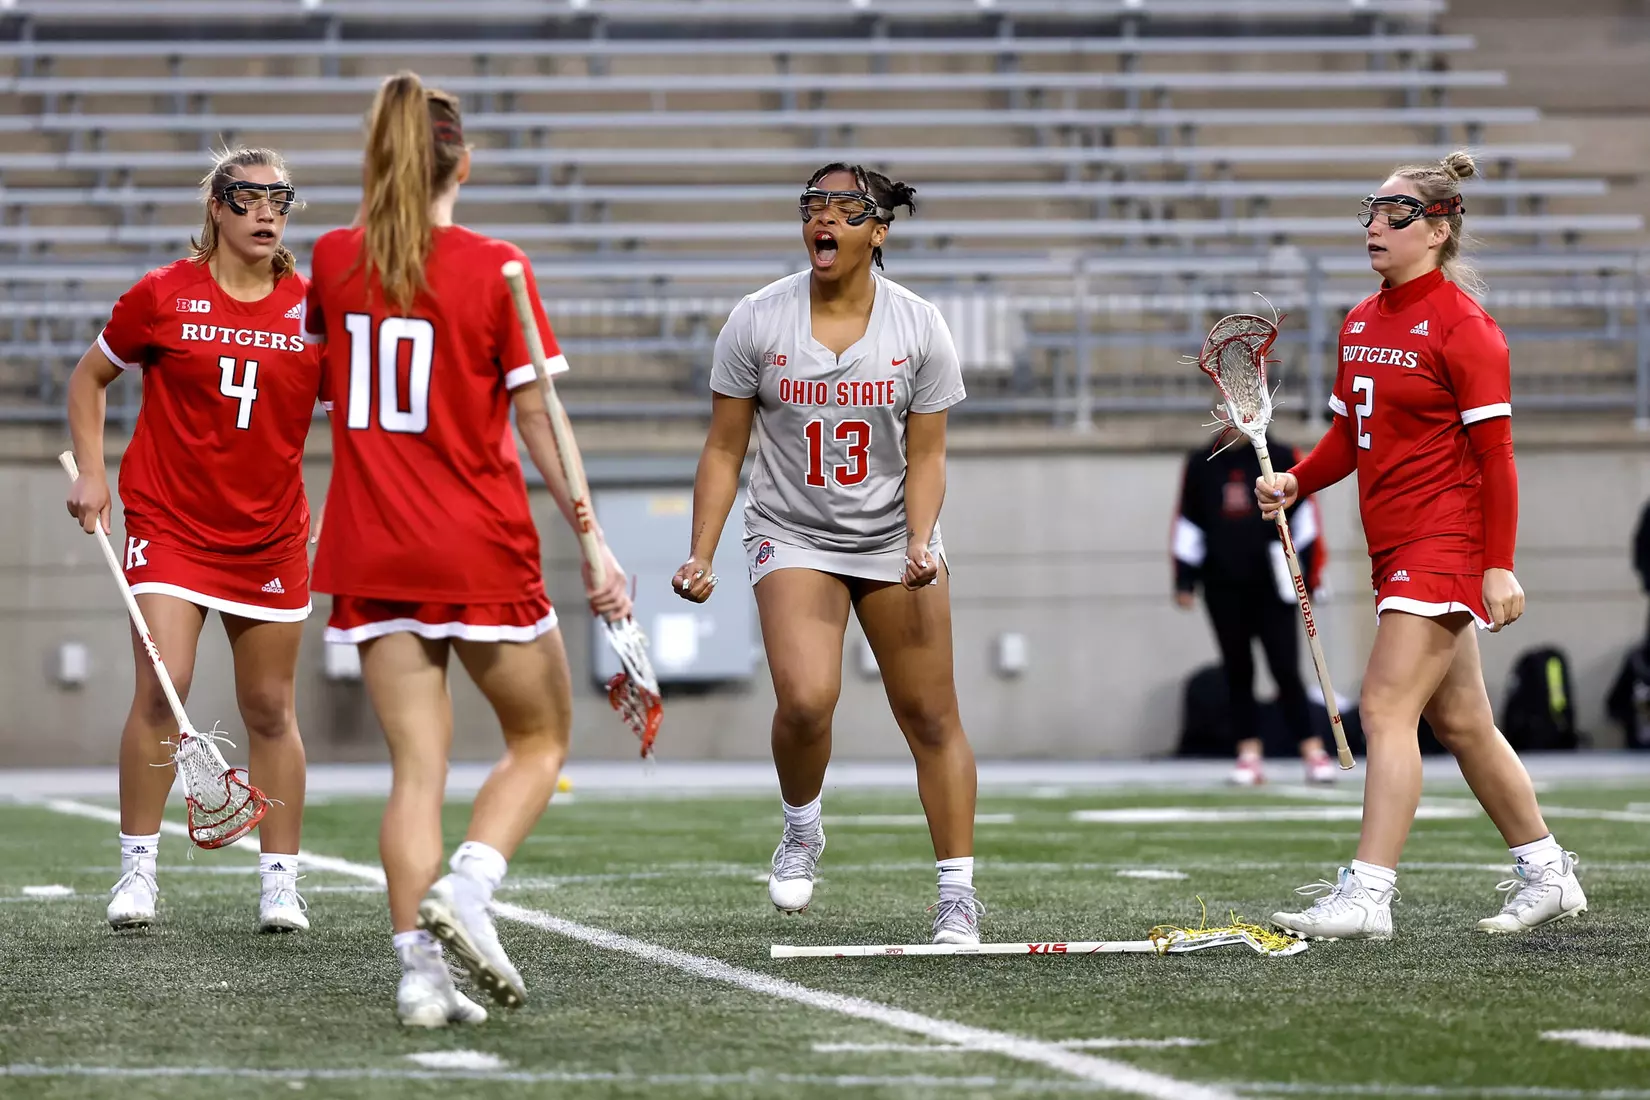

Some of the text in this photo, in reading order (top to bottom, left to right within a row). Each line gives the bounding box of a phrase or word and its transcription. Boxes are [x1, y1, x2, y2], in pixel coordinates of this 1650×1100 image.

[181, 323, 305, 352] RUTGERS
[1410, 328, 1429, 336] adidas
[1343, 345, 1418, 368] RUTGERS
[344, 312, 435, 434] 10
[218, 356, 259, 430] 4
[779, 378, 895, 406] OHIO STATE
[1352, 375, 1375, 450] 2
[803, 419, 872, 488] 13
[261, 586, 285, 594] adidas
[1294, 574, 1317, 638] RUTGERS
[1027, 943, 1068, 955] STX
